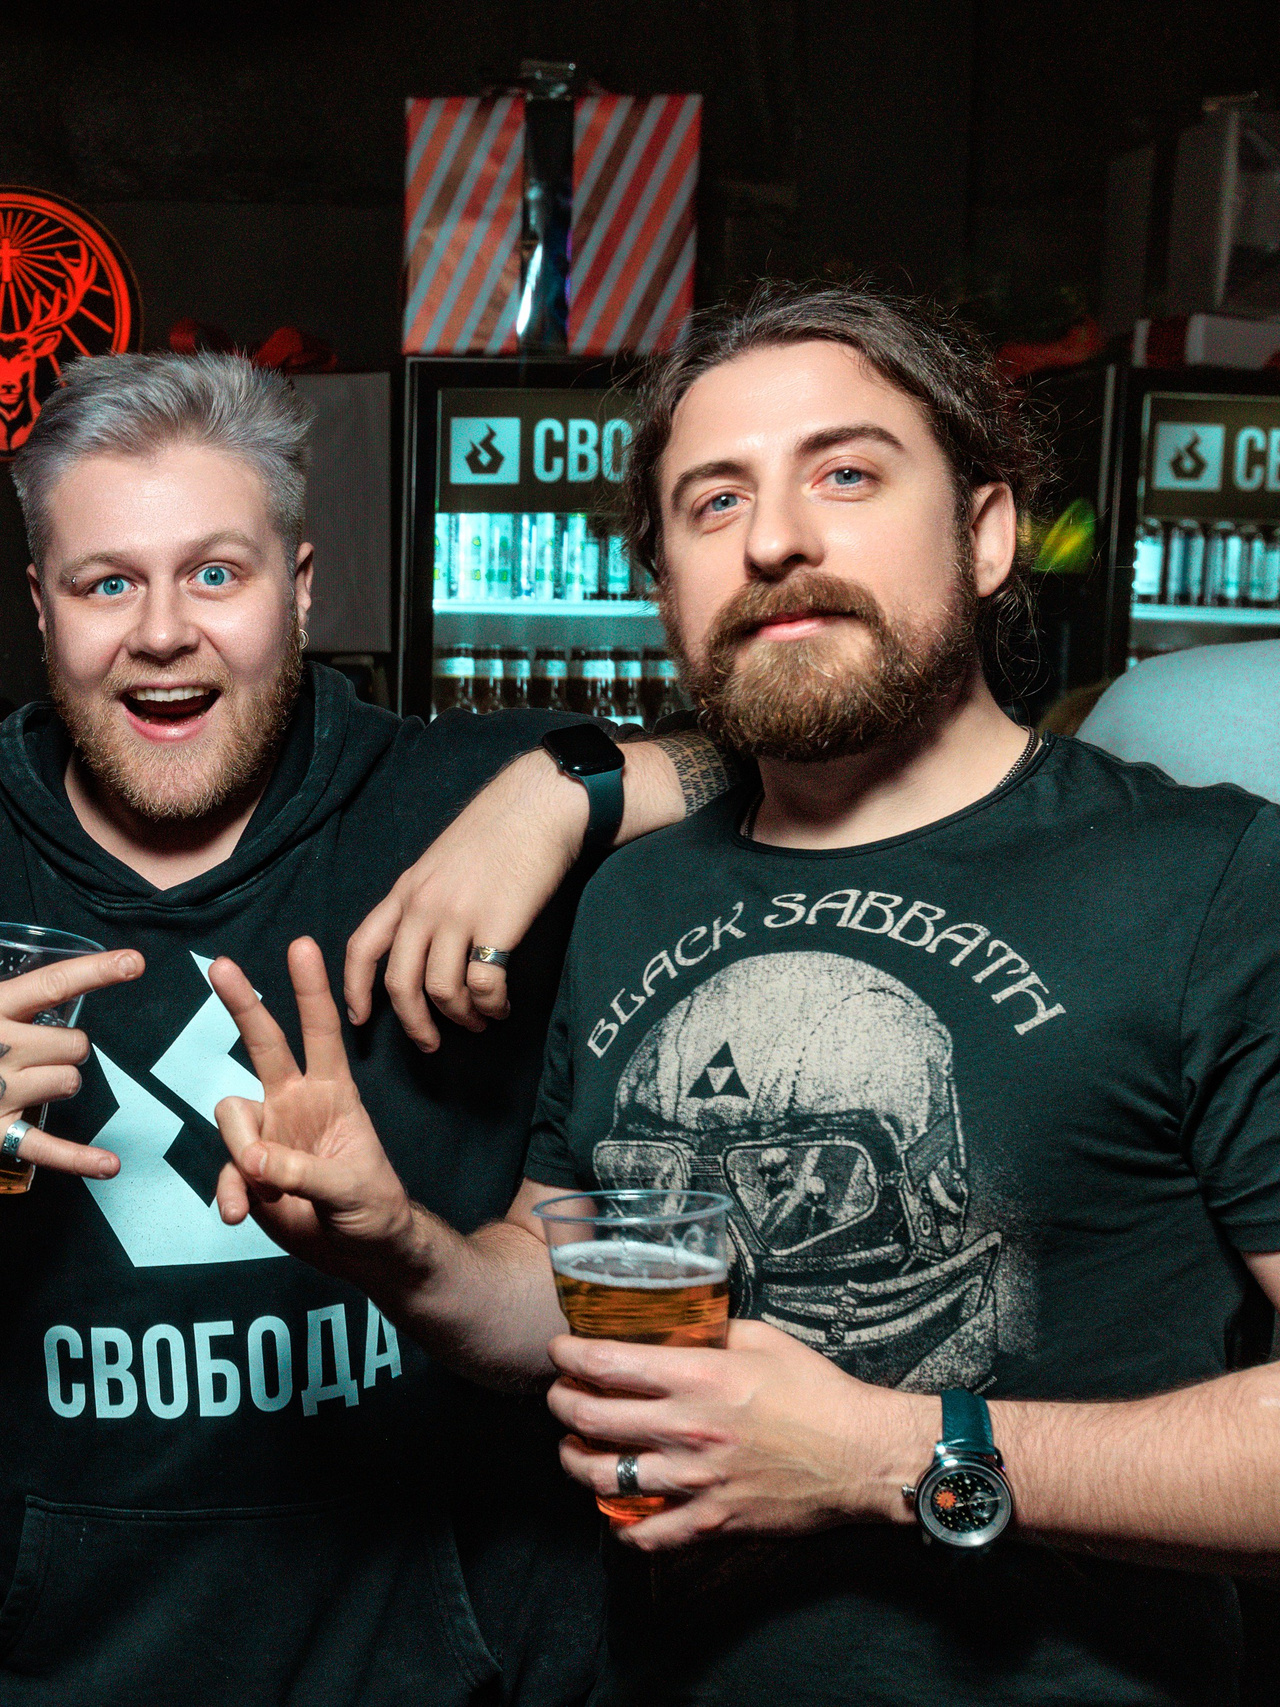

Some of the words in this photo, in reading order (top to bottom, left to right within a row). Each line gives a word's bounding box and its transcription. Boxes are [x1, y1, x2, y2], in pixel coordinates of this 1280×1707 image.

[533, 418, 634, 482] СВО
[586, 901, 746, 1058] BLACK
[763, 889, 1066, 1036] SABBATH
[43, 1297, 402, 1420] СВОБОДА
